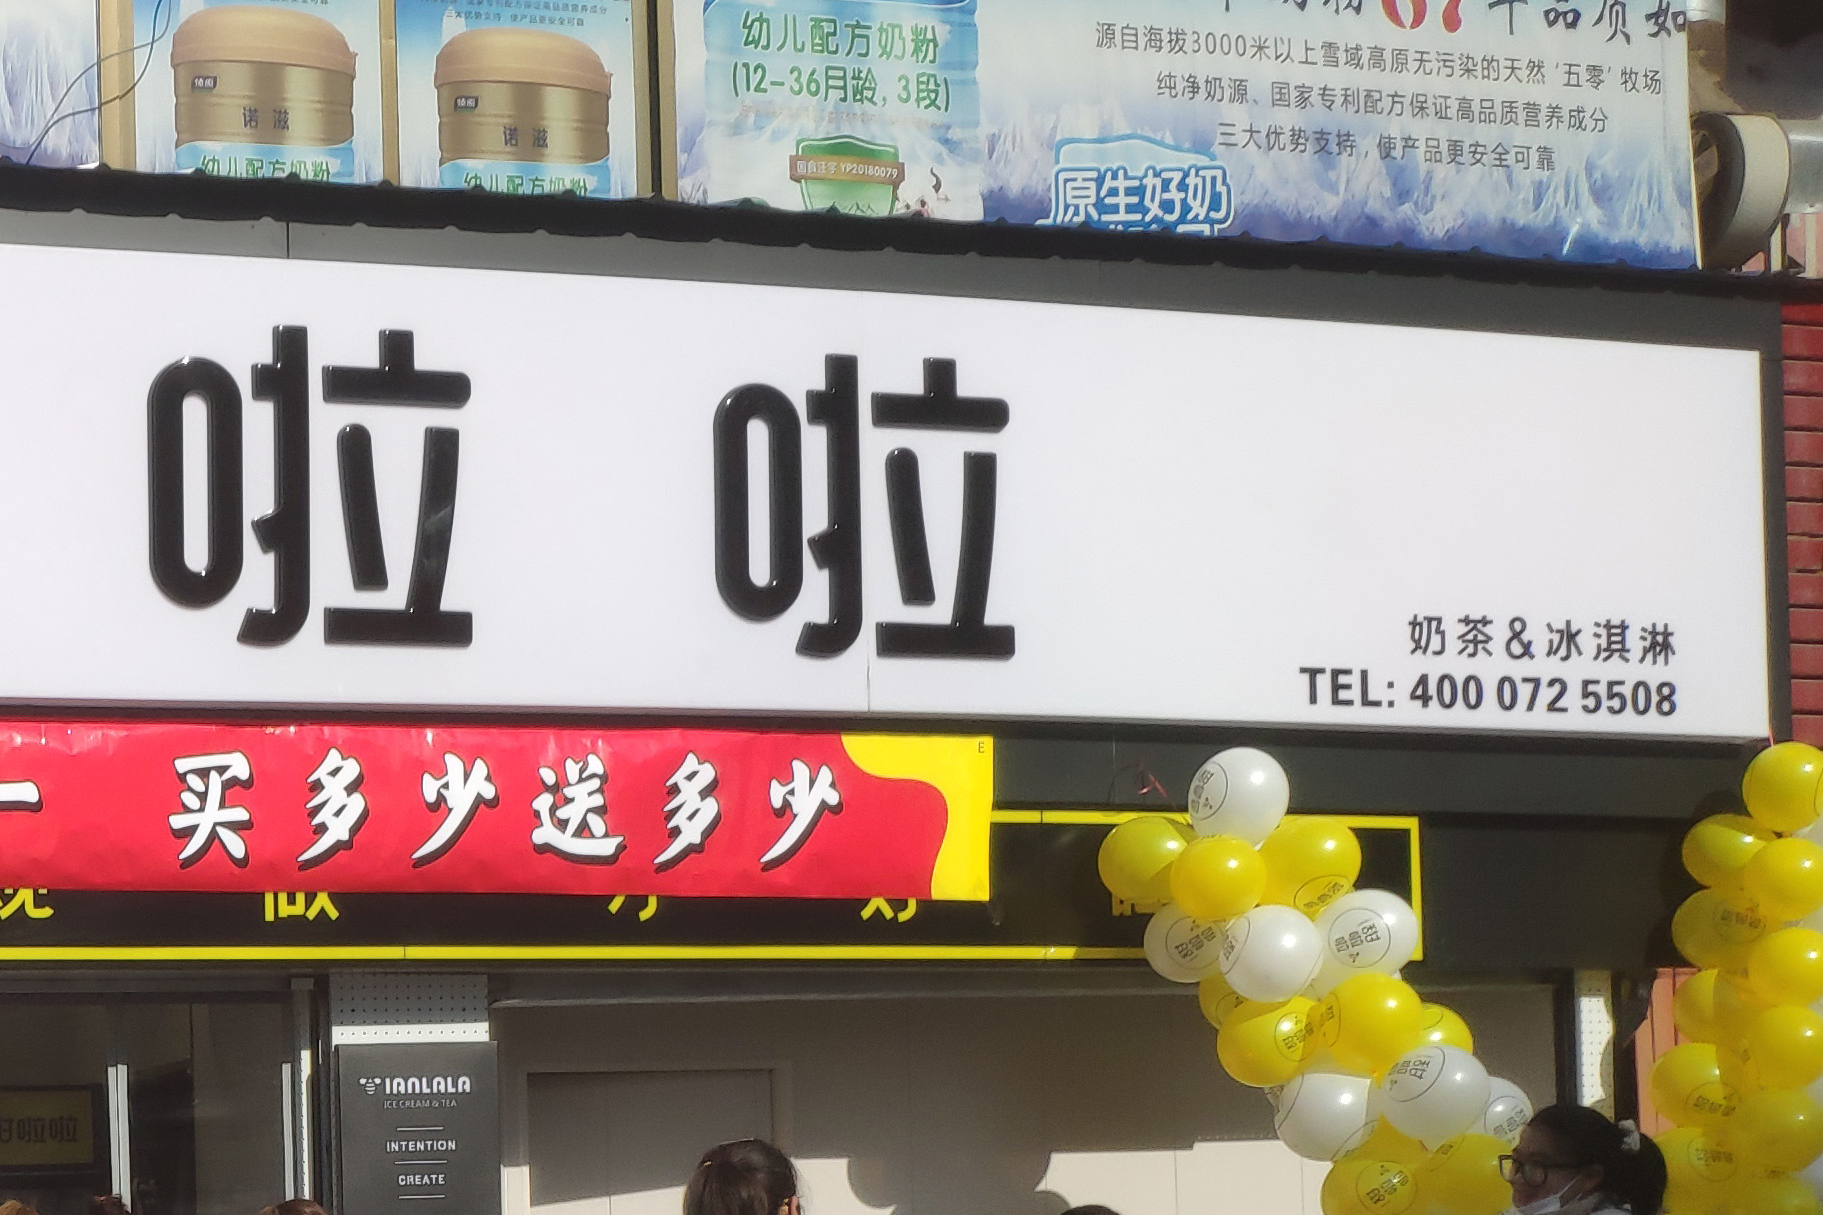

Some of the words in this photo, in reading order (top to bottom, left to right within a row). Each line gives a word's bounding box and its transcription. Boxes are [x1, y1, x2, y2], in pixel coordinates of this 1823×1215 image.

[741, 10, 939, 65] 幼儿配方奶粉
[1059, 168, 1228, 224] 原生好奶
[1408, 613, 1676, 666] 奶茶&冰淇淋
[1299, 666, 1395, 708] TEL:
[1409, 672, 1484, 710] 400
[1497, 675, 1569, 714] 072
[1580, 678, 1677, 717] 5508
[168, 746, 843, 871] 买多少送多少
[386, 1139, 457, 1153] INTENTION
[398, 1174, 446, 1186] CREATE
